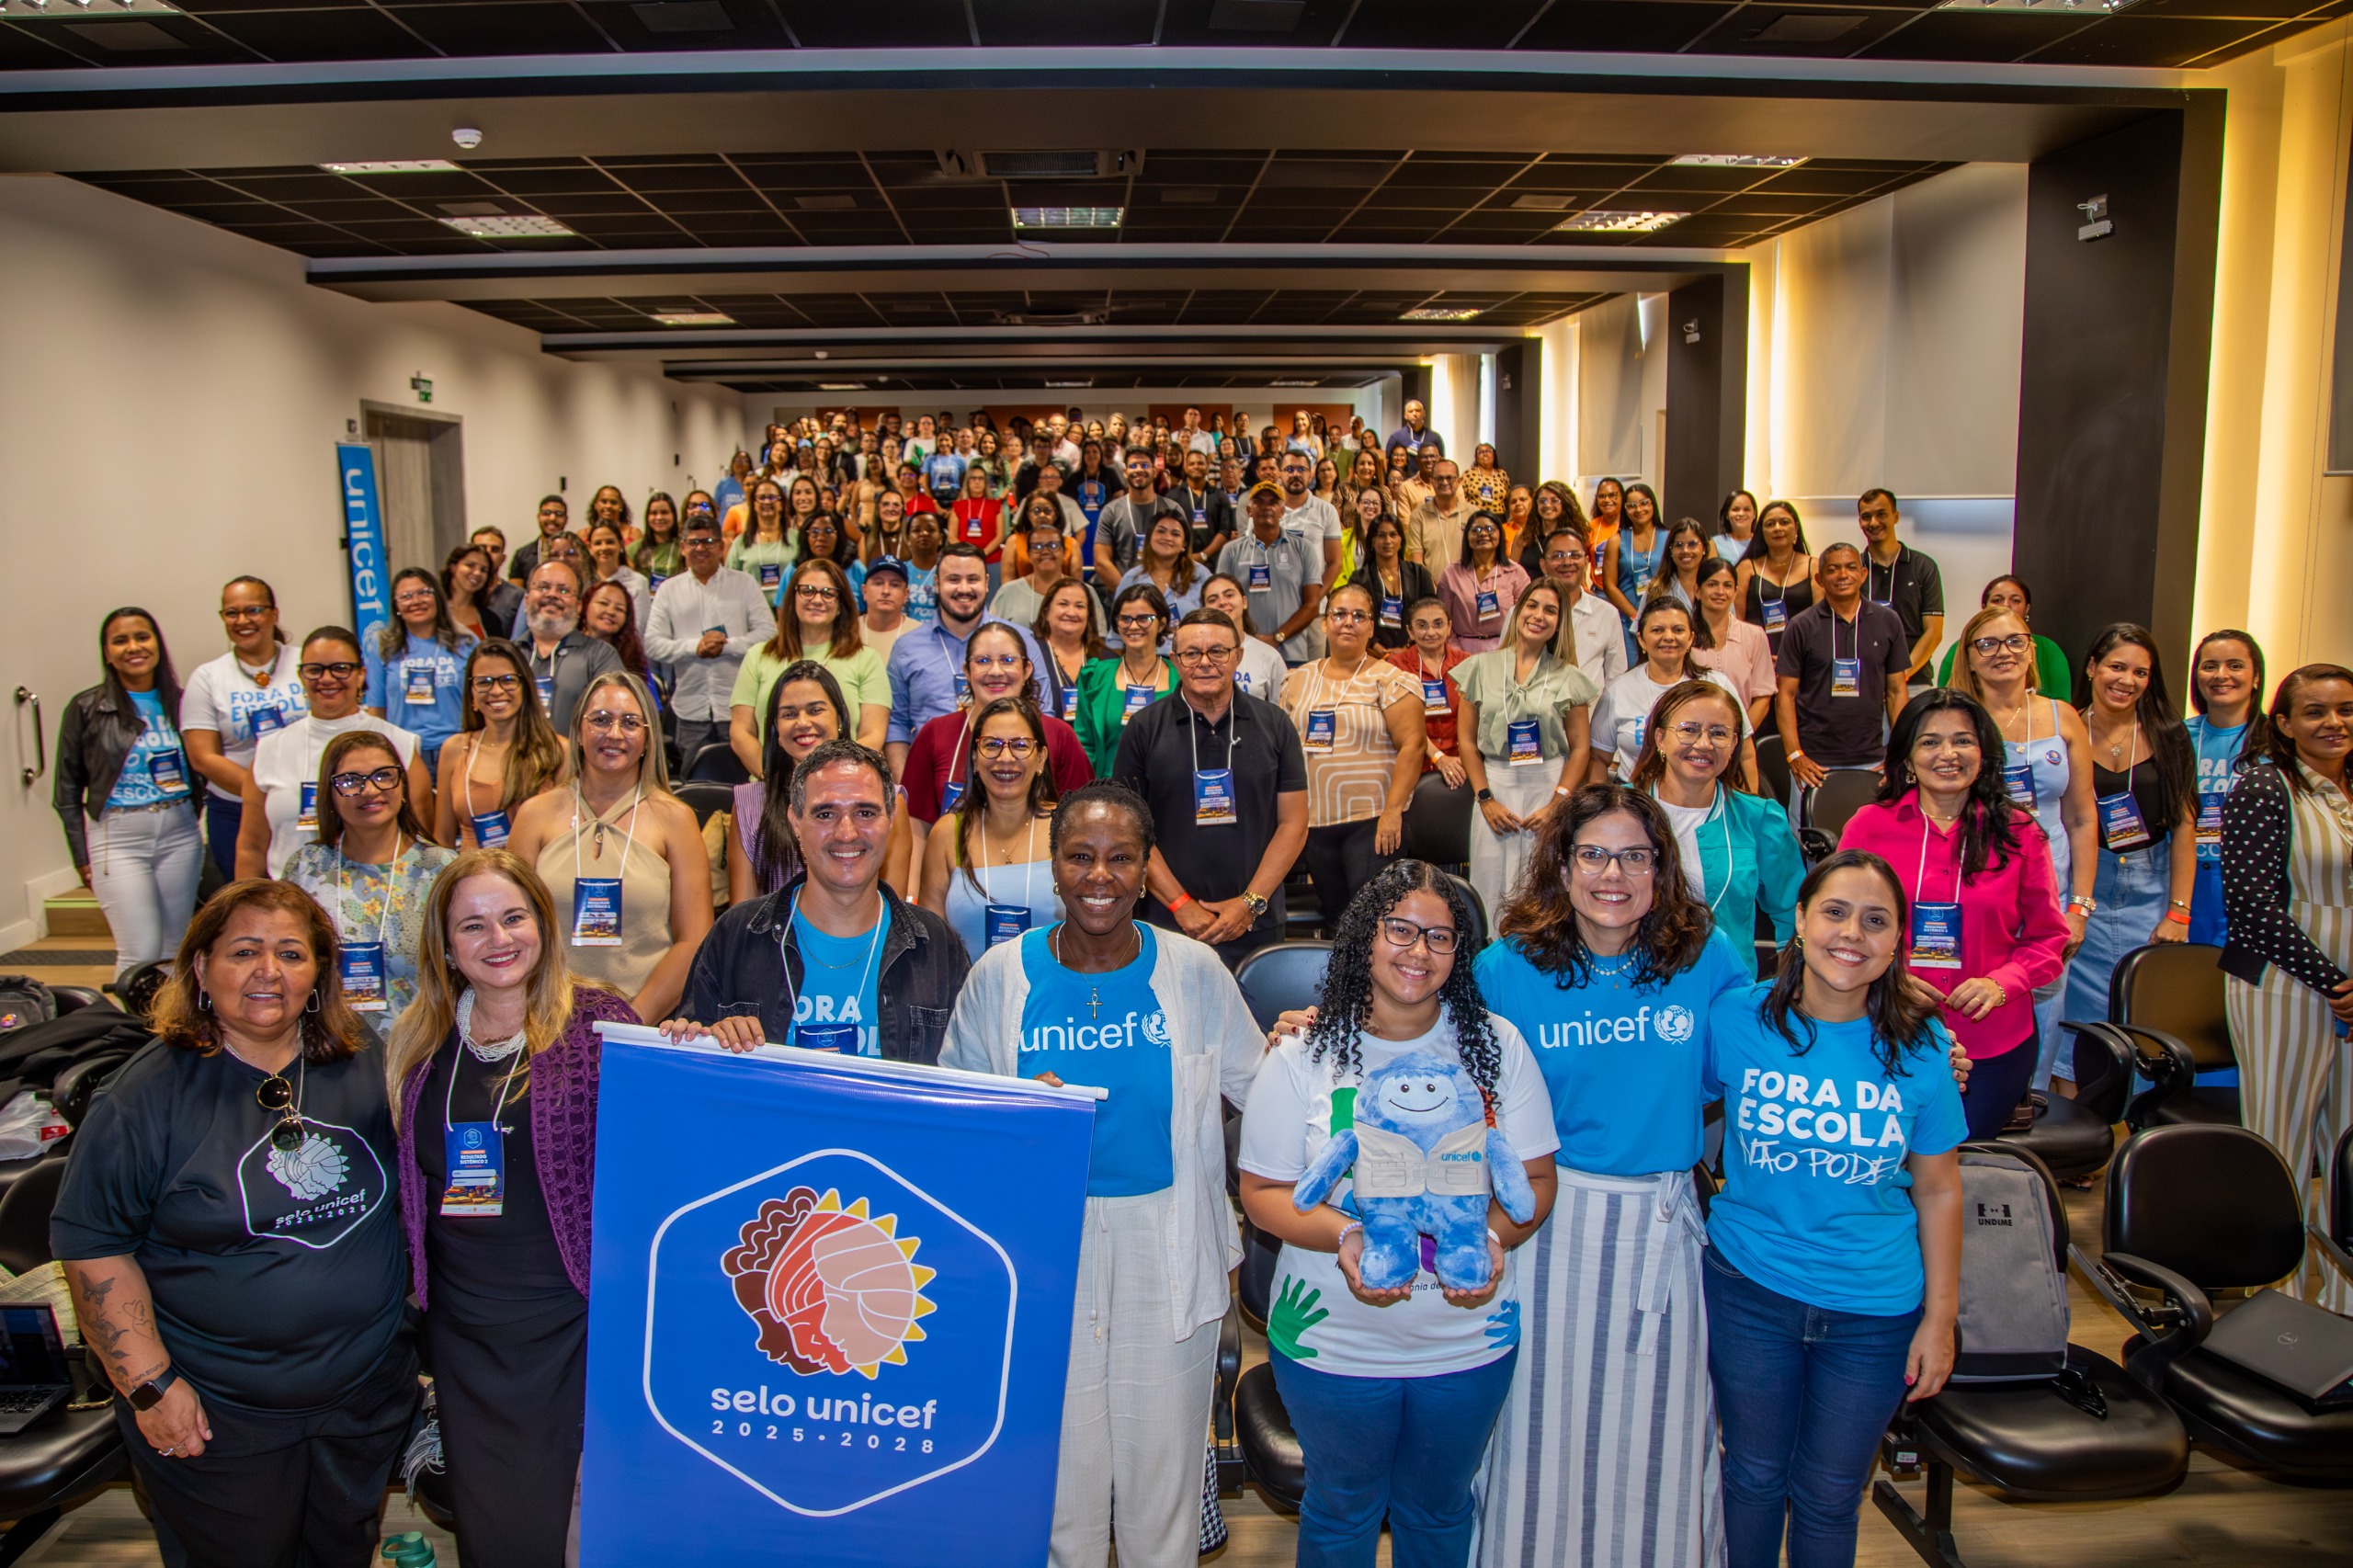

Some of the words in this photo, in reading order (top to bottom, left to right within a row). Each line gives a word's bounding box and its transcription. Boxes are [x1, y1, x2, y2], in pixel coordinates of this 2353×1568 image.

[345, 467, 386, 615] unicef
[231, 687, 283, 705] FORA
[2197, 757, 2227, 777] RA
[791, 994, 863, 1023] ORA
[1539, 1006, 1651, 1049] unicef
[1019, 1011, 1138, 1052] unicef
[1740, 1068, 1842, 1109] FORA
[1856, 1080, 1904, 1114] DA
[1737, 1096, 1905, 1149] ESCOLA
[1440, 1150, 1472, 1162] unicef
[1738, 1131, 1799, 1176] NÃO
[275, 1209, 312, 1225] selo
[313, 1187, 366, 1213] unicef
[1978, 1218, 2013, 1227] UNDIME
[710, 1384, 797, 1417] selo
[806, 1392, 938, 1430] unicef
